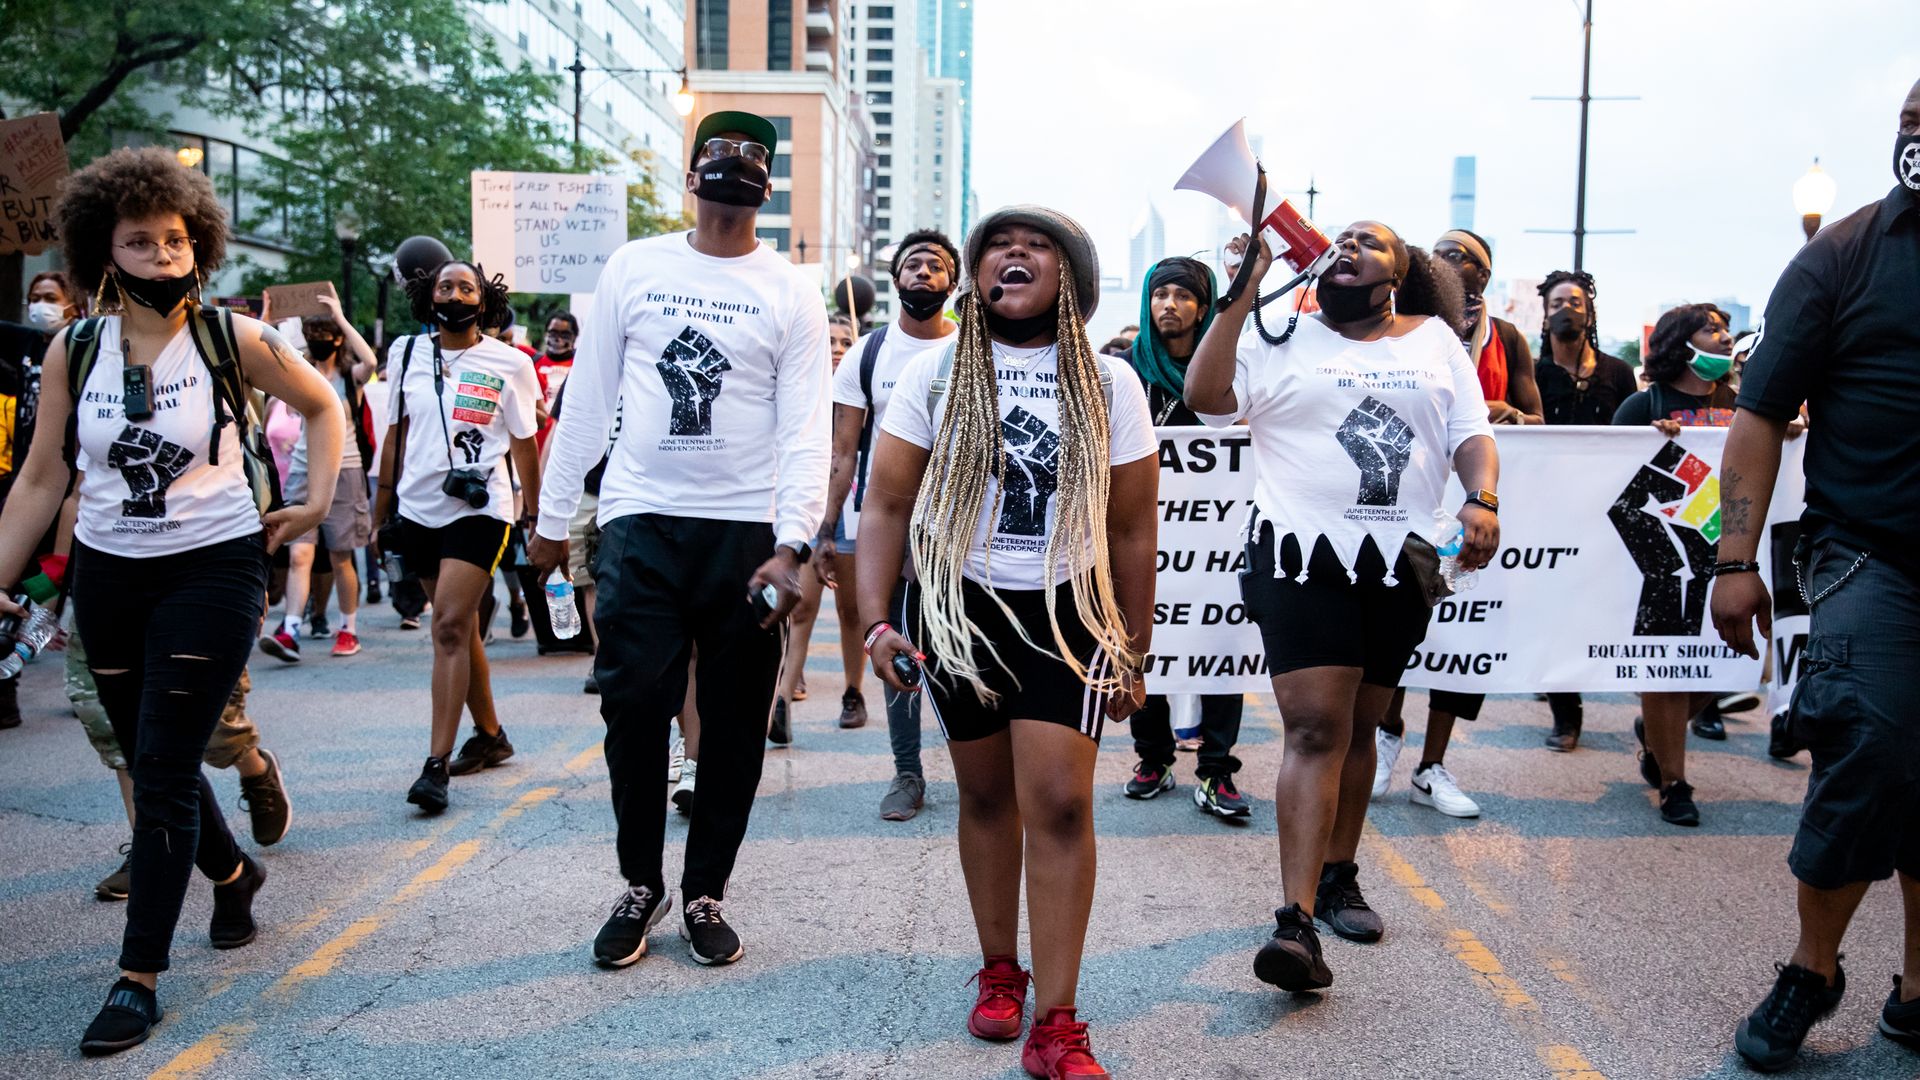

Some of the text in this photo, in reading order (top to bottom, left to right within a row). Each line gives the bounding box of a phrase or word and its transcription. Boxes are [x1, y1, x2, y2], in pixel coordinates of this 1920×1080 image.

[479, 179, 511, 192] Tired
[2, 195, 52, 221] BUT
[479, 198, 510, 210] Tired
[530, 201, 550, 211] ALL
[515, 218, 606, 232] STAND WITH
[540, 234, 560, 247] US
[515, 255, 535, 268] OR
[539, 254, 588, 266] STAND
[541, 268, 567, 284] US
[646, 293, 760, 315] EQUALITY SHOULD
[662, 306, 736, 325] BE NORMAL
[1337, 378, 1420, 390] BE NORMAL
[1009, 385, 1058, 399] NORMA
[97, 408, 115, 419] BE
[1158, 438, 1251, 473] AST
[1344, 514, 1394, 522] INDEPENDENCE
[1156, 551, 1195, 572] OU
[1205, 551, 1247, 572] HA
[1501, 547, 1579, 570] OUT"
[1153, 604, 1192, 625] SE
[1437, 600, 1503, 623] DIE"
[1588, 644, 1669, 659] EQUALITY
[1404, 650, 1507, 676] OUNG"
[1616, 665, 1712, 679] BE NORMAL
